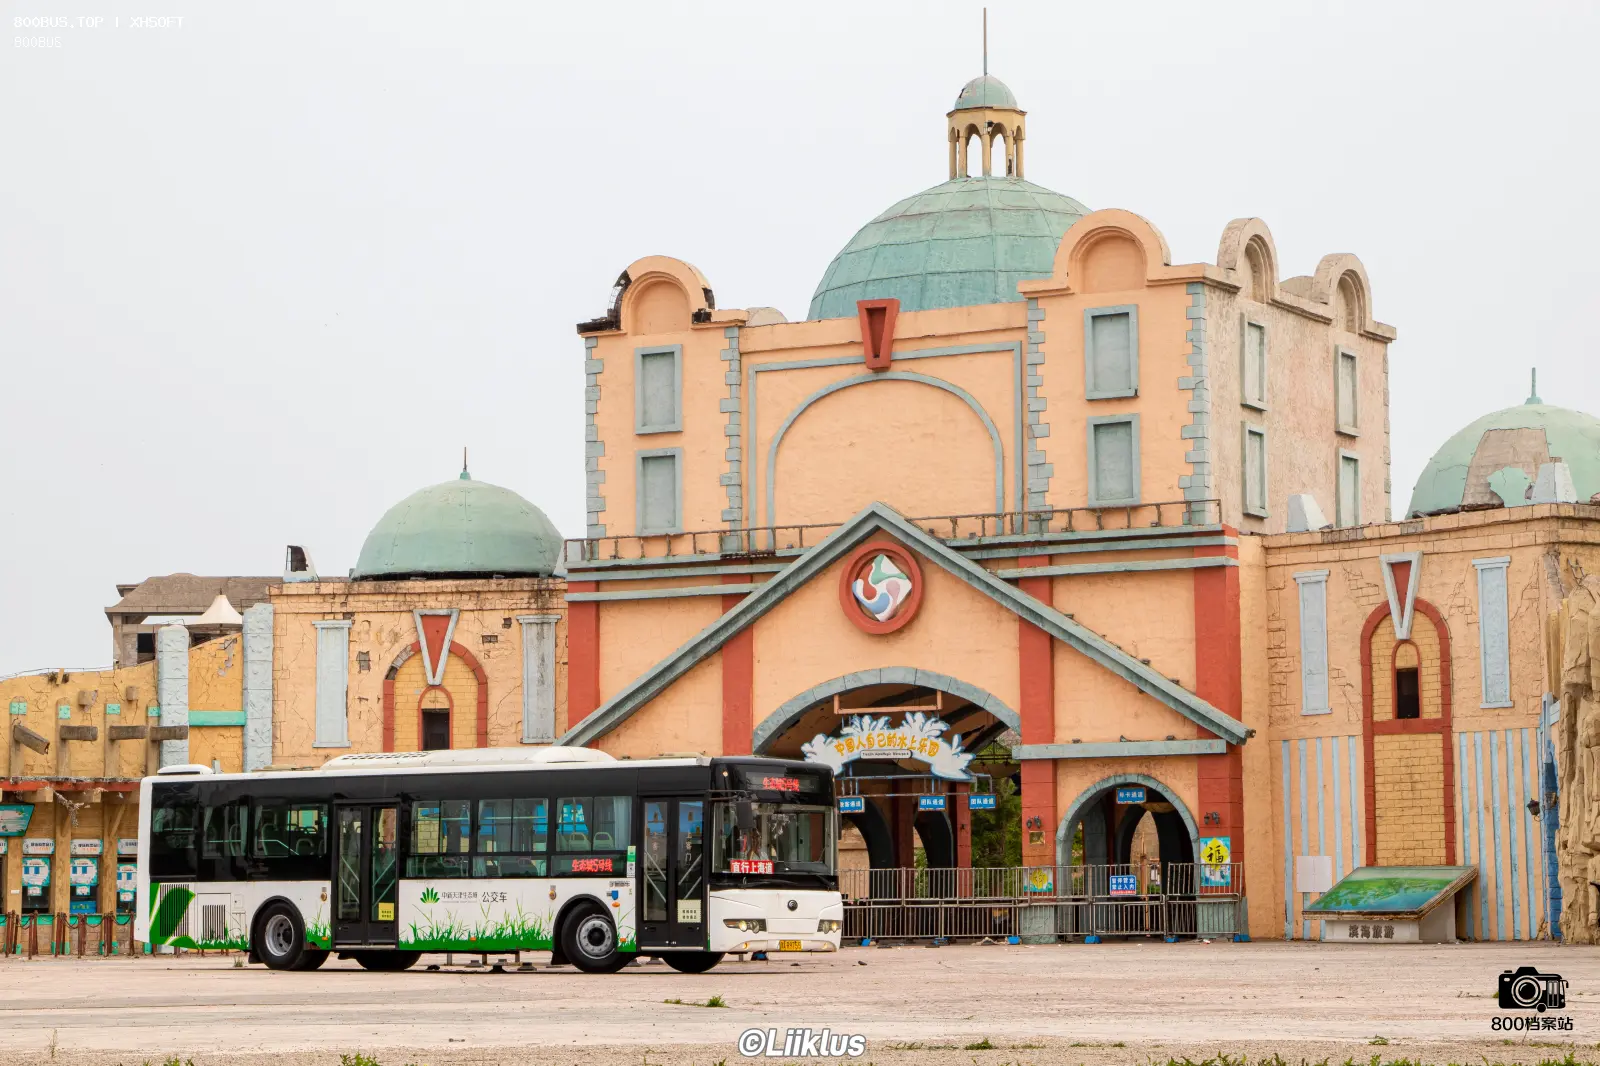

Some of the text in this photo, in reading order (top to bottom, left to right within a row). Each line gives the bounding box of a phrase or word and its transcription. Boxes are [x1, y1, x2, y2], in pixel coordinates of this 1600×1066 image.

[834, 732, 940, 757] 中国人自己的水上乐园
[1206, 845, 1224, 863] 福
[571, 858, 613, 873] 生态城5号线
[731, 861, 773, 874] 直行上海道
[481, 891, 508, 903] 公交车
[1348, 923, 1395, 939] 滨海旅游
